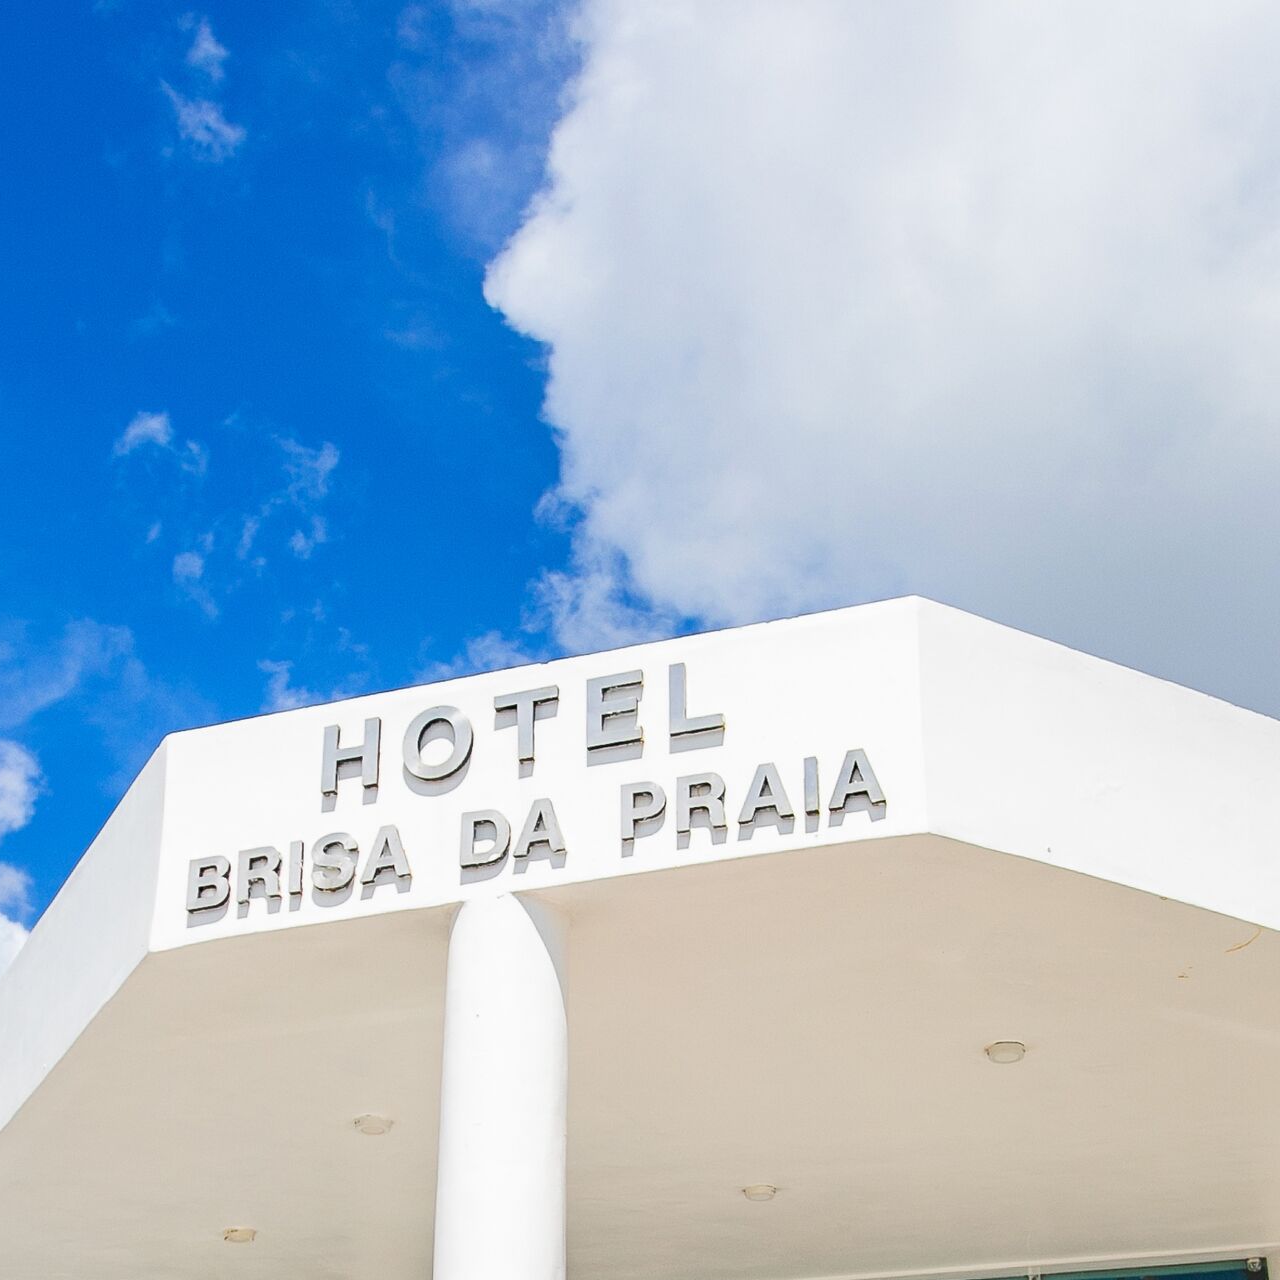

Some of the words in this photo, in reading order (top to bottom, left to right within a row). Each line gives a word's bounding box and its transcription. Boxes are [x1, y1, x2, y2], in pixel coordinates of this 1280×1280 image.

[321, 662, 726, 797] HOTEL
[185, 823, 413, 914] BRISA
[460, 797, 567, 872] DA
[620, 747, 888, 841] PRAIA
